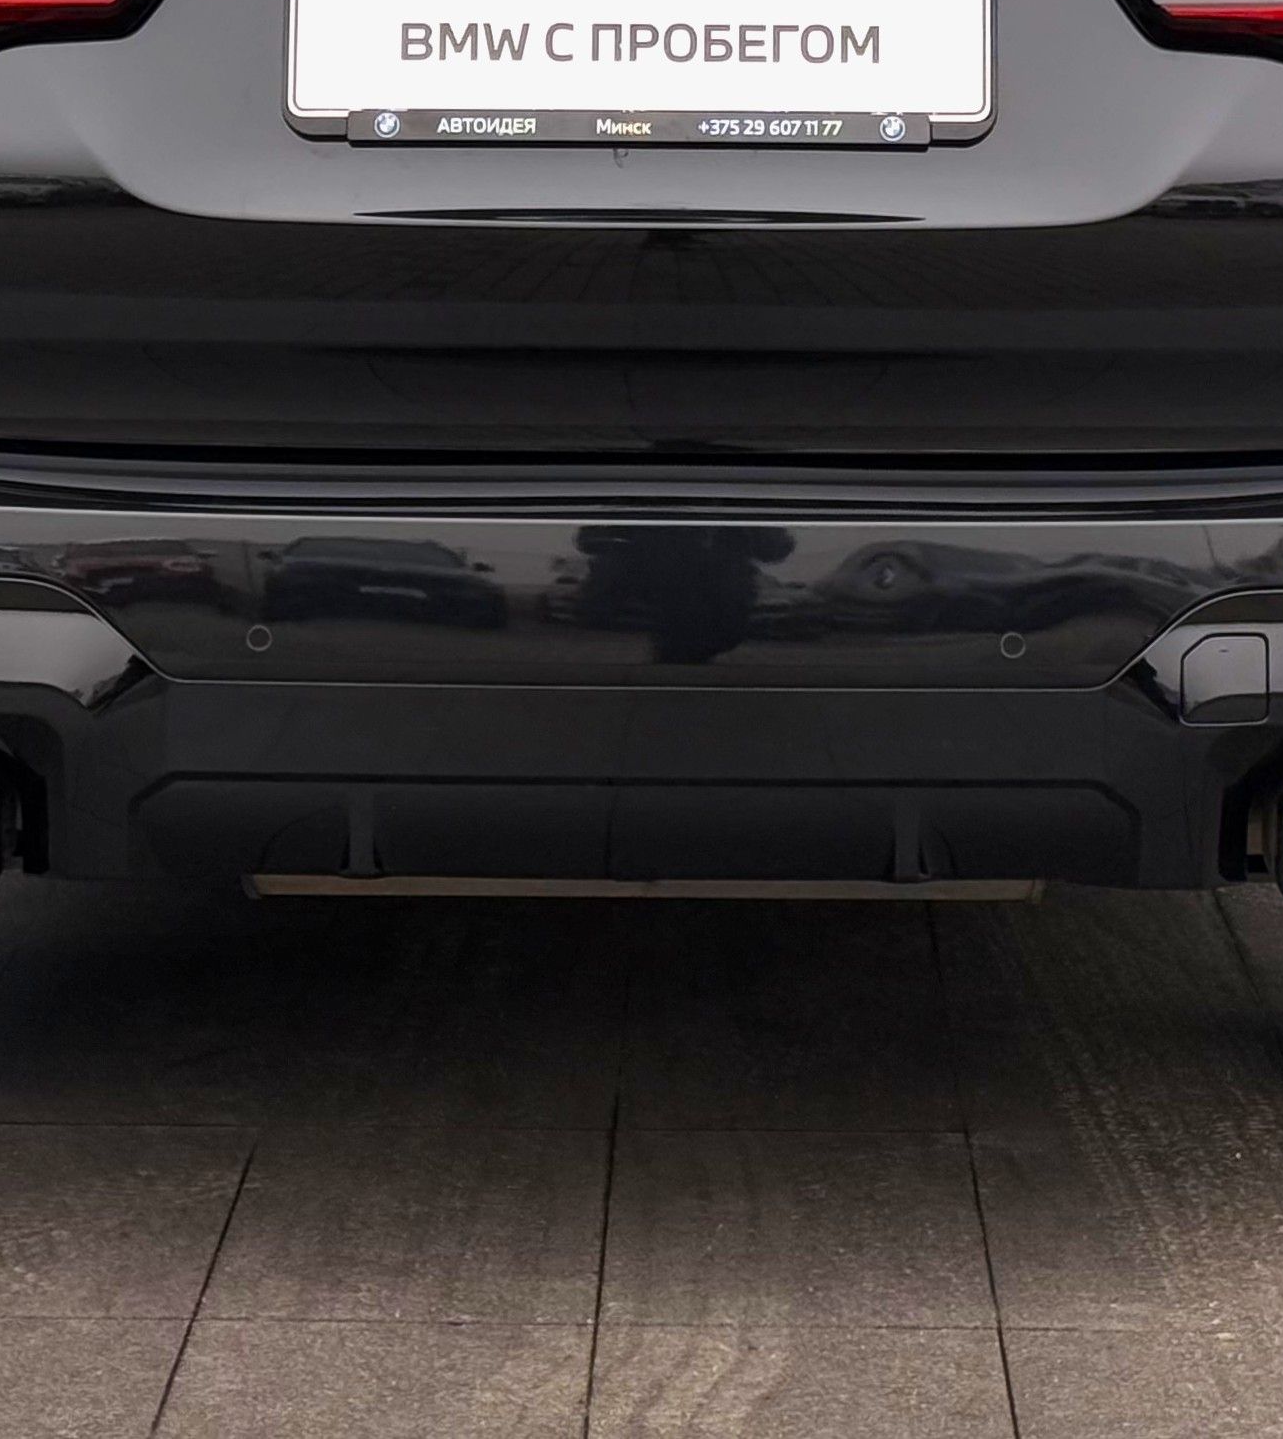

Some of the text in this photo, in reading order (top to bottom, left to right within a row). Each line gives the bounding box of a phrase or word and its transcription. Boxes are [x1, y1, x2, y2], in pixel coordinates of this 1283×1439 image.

[401, 22, 880, 63] BMW С ПРОБЕГОМ
[436, 117, 843, 137] АВТОИДЕЯ Минск +375 29 607 11 77
